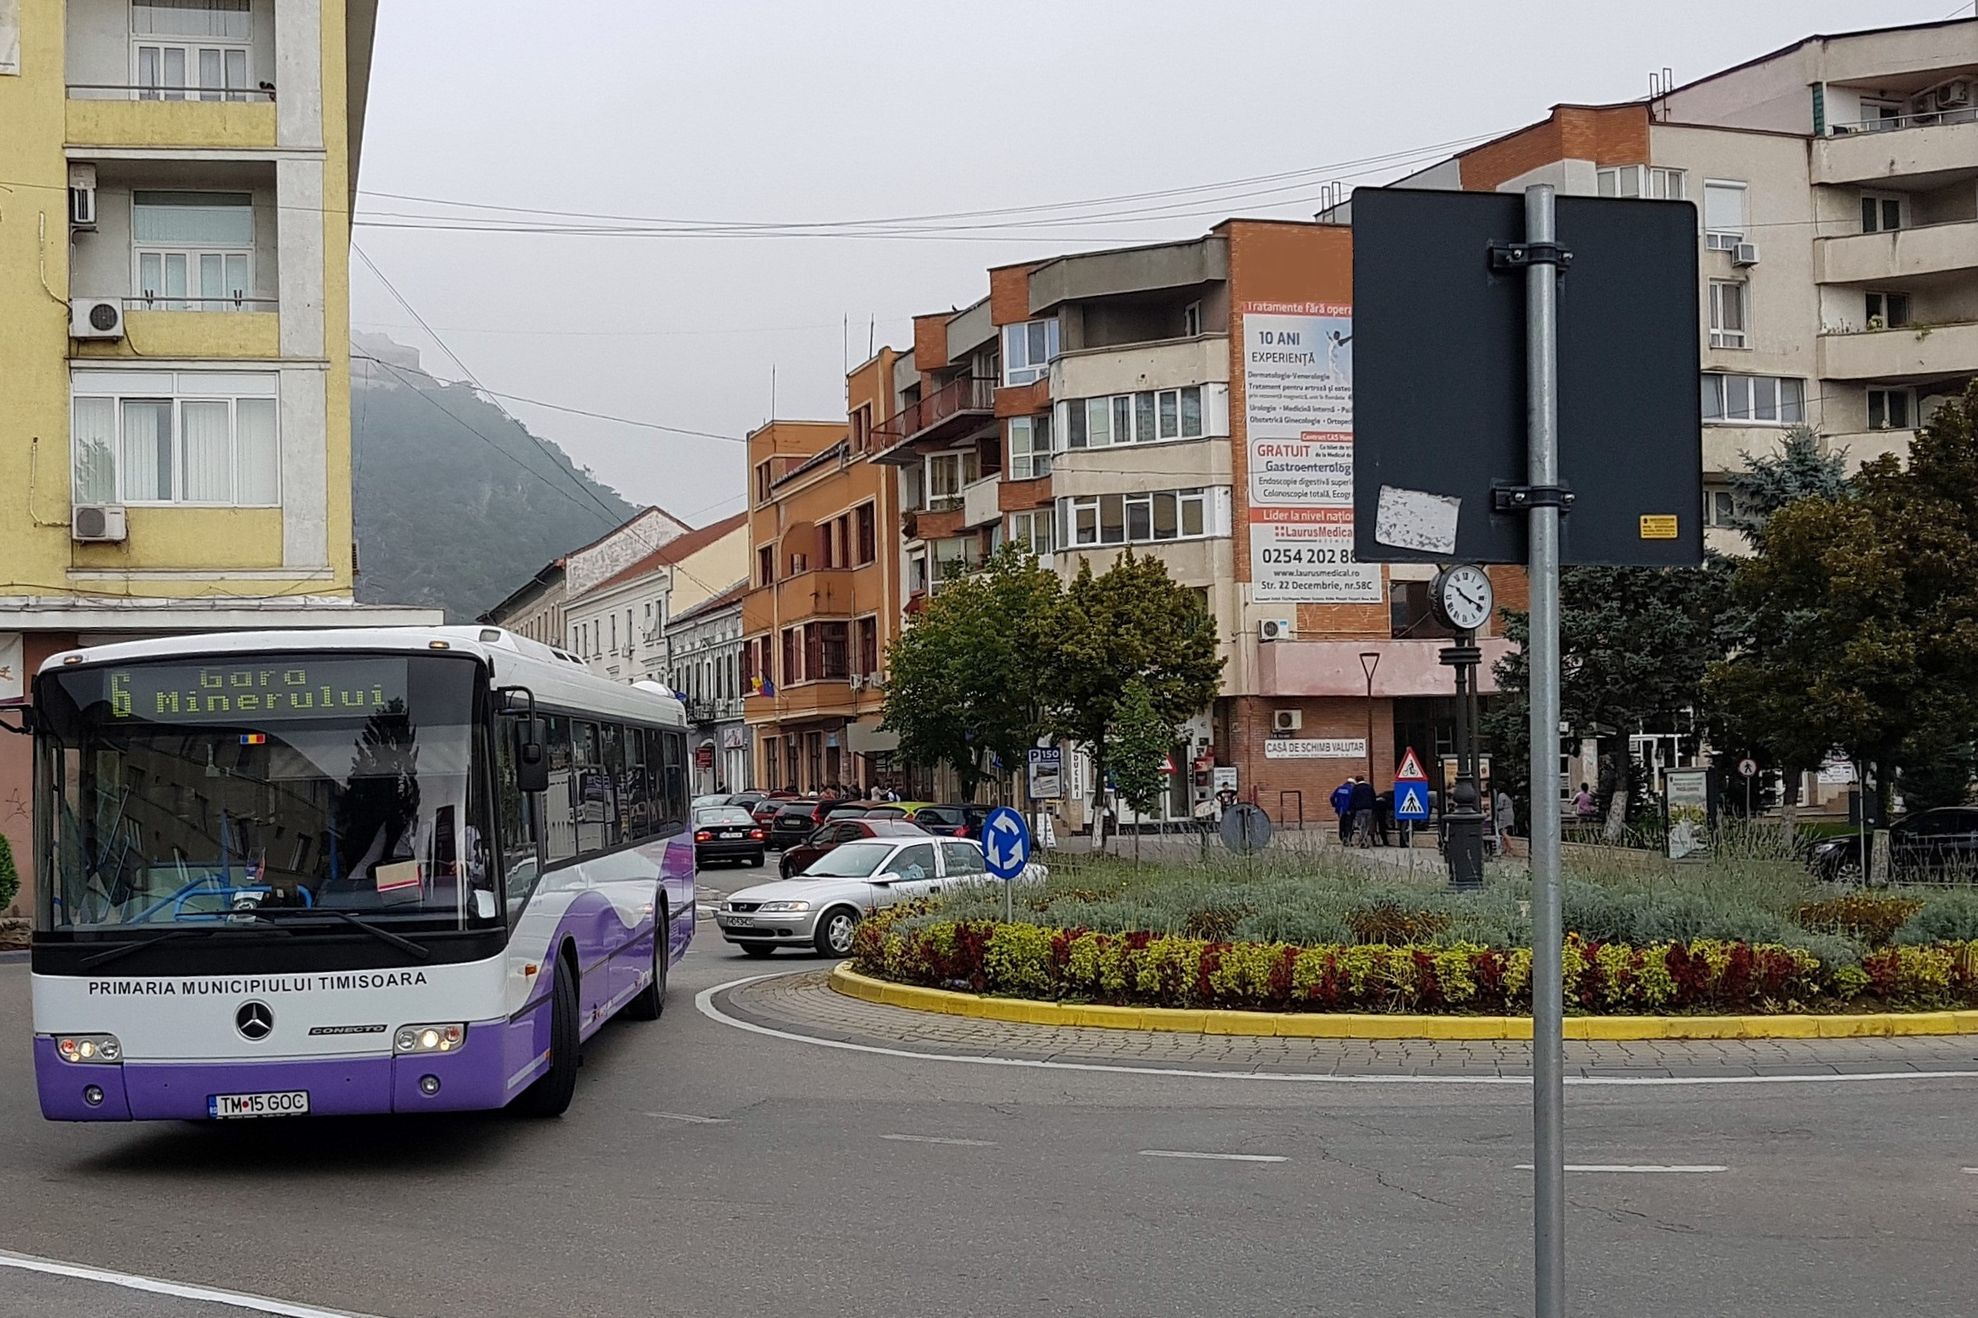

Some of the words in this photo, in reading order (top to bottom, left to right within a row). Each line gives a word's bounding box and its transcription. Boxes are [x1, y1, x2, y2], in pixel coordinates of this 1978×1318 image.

[1247, 302, 1303, 313] Tratamente
[1305, 302, 1325, 314] fără
[1259, 331, 1273, 345] 10
[1277, 331, 1300, 346] ANI
[1257, 444, 1310, 457] GRATUIT
[1265, 460, 1352, 476] Gastroenterolog
[1259, 477, 1297, 487] Endoscopie
[1263, 489, 1308, 499] Colonoscopie
[1263, 509, 1289, 521] Lider
[1291, 510, 1299, 521] la
[1301, 510, 1325, 521] nivel
[1263, 549, 1302, 564] 0254
[1307, 549, 1336, 564] 202
[1273, 568, 1360, 577] www.laurusmedical.ro
[1261, 581, 1276, 590] Str.
[1279, 581, 1289, 590] 22
[1292, 581, 1342, 592] Decembrie,
[111, 672, 131, 718] 6
[156, 684, 385, 713] Minerului
[1266, 741, 1287, 753] CASĂ
[1289, 742, 1299, 752] DE
[1300, 742, 1331, 752] SCHIMB
[1332, 742, 1365, 752] VALUTAR
[1042, 750, 1059, 759] 150
[89, 981, 176, 996] PRIMARIA
[182, 976, 313, 996] MUNICIPIULUI
[318, 971, 428, 991] TIMISOARA
[311, 1025, 385, 1035] CONECTO
[267, 1094, 304, 1111] GOC
